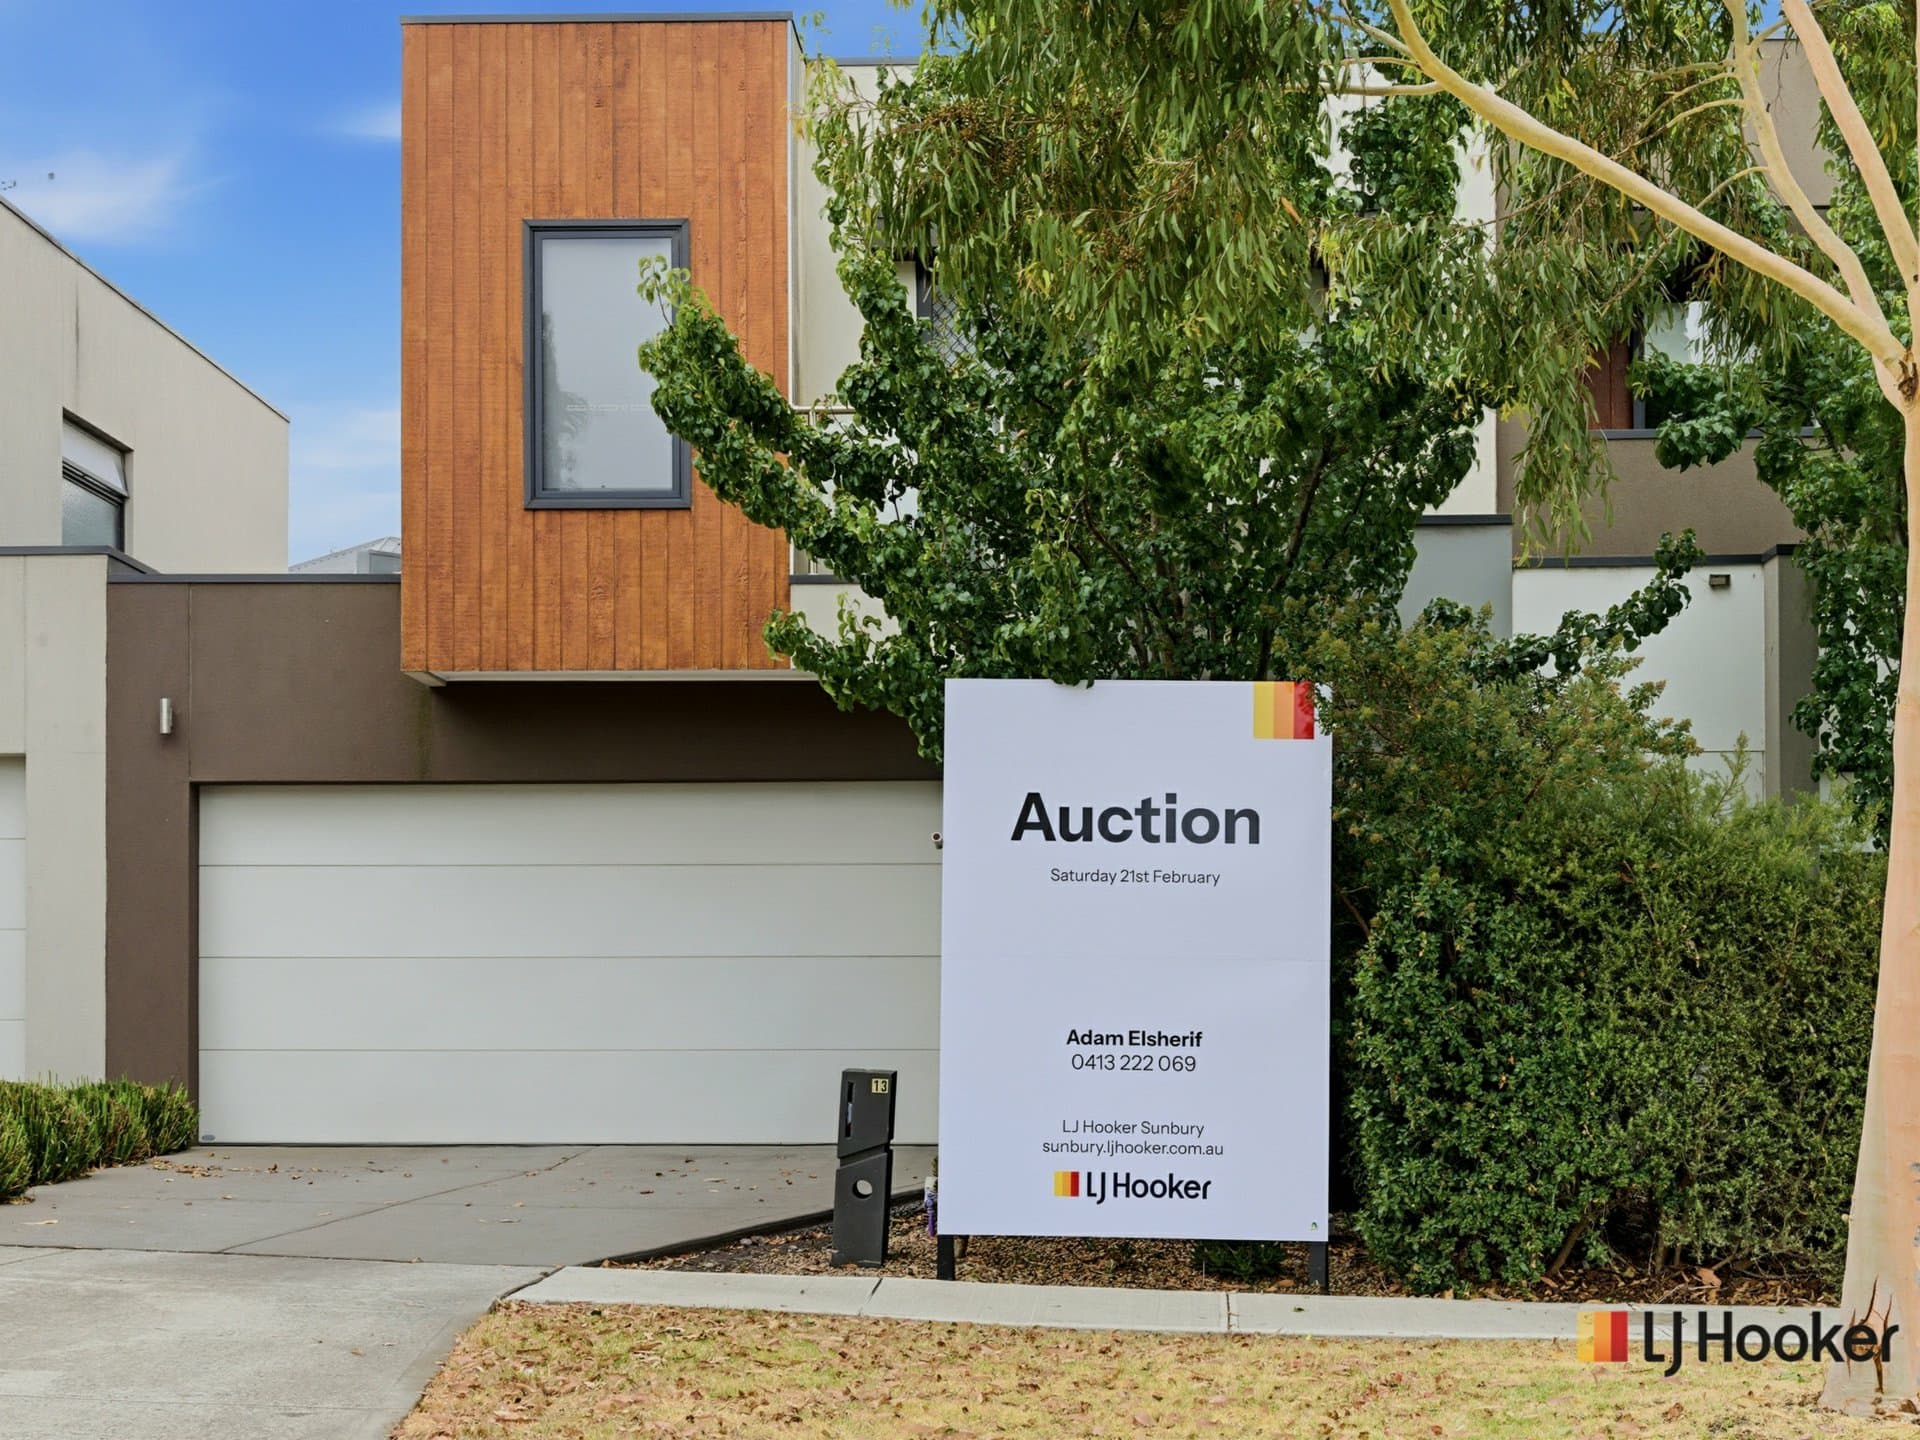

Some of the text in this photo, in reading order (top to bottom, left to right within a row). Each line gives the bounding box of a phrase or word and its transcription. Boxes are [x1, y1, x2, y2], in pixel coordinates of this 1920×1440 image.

[1011, 792, 1260, 844] Auction
[1051, 868, 1220, 887] Saturday 21st February
[1066, 1029, 1203, 1047] Adam Elsherif
[1072, 1054, 1196, 1072] 0413 222 069
[873, 1080, 887, 1092] 13
[1063, 1120, 1204, 1138] LJ Hooker Sunbury
[1043, 1140, 1223, 1157] sunbury.ljhooker.com.au
[1087, 1171, 1212, 1205] LJ Hooker
